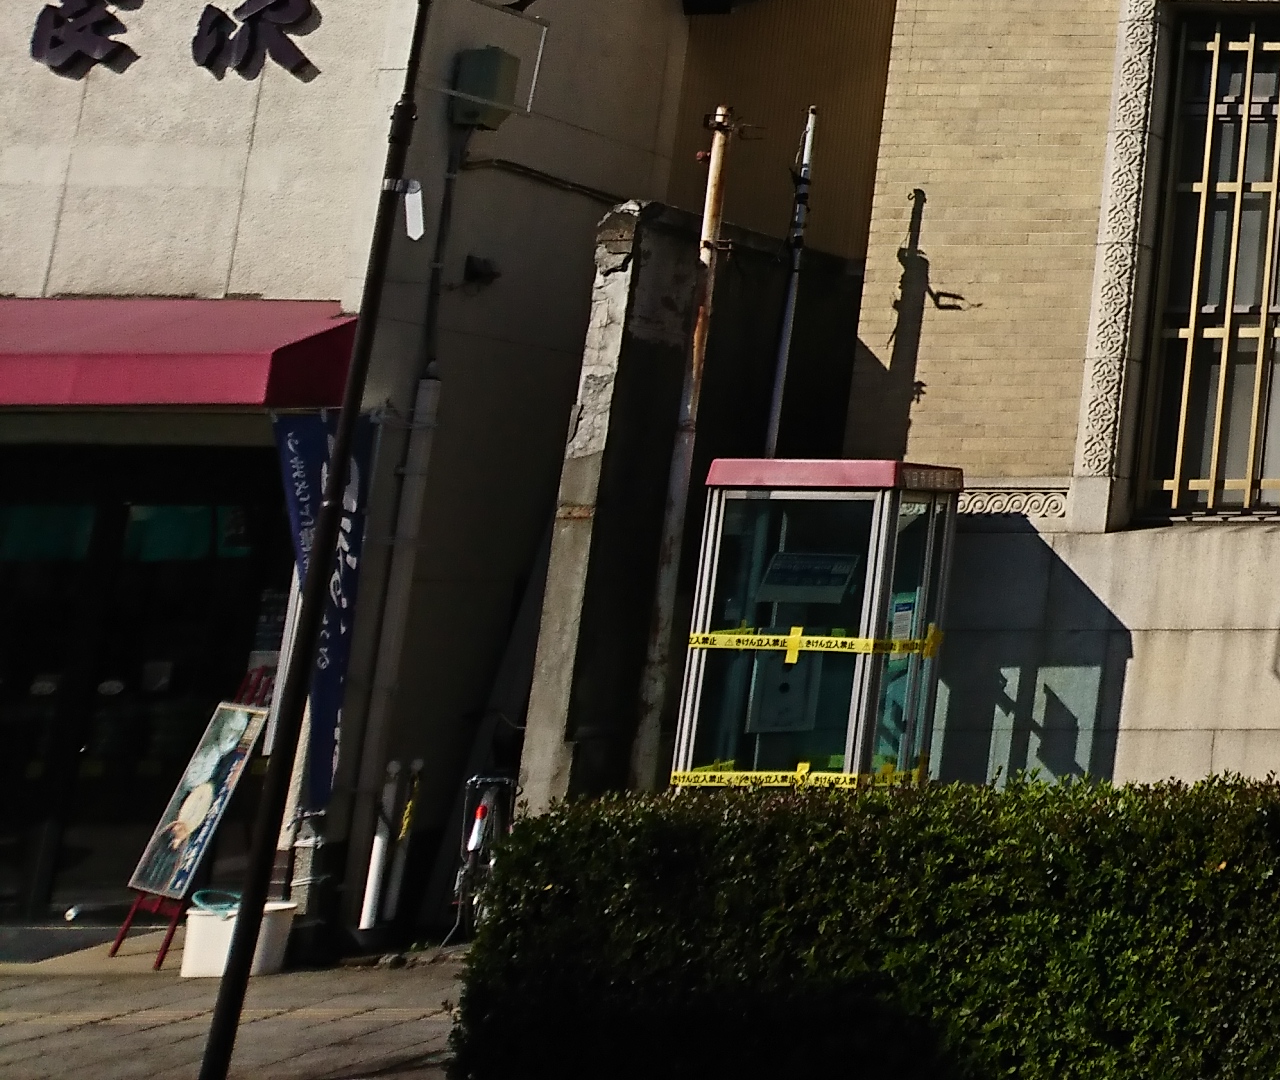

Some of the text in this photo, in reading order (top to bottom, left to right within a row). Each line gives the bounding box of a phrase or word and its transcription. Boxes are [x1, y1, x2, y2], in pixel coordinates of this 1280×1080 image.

[735, 638, 788, 648] きけん立入禁止
[805, 639, 856, 650] きけん立入禁止
